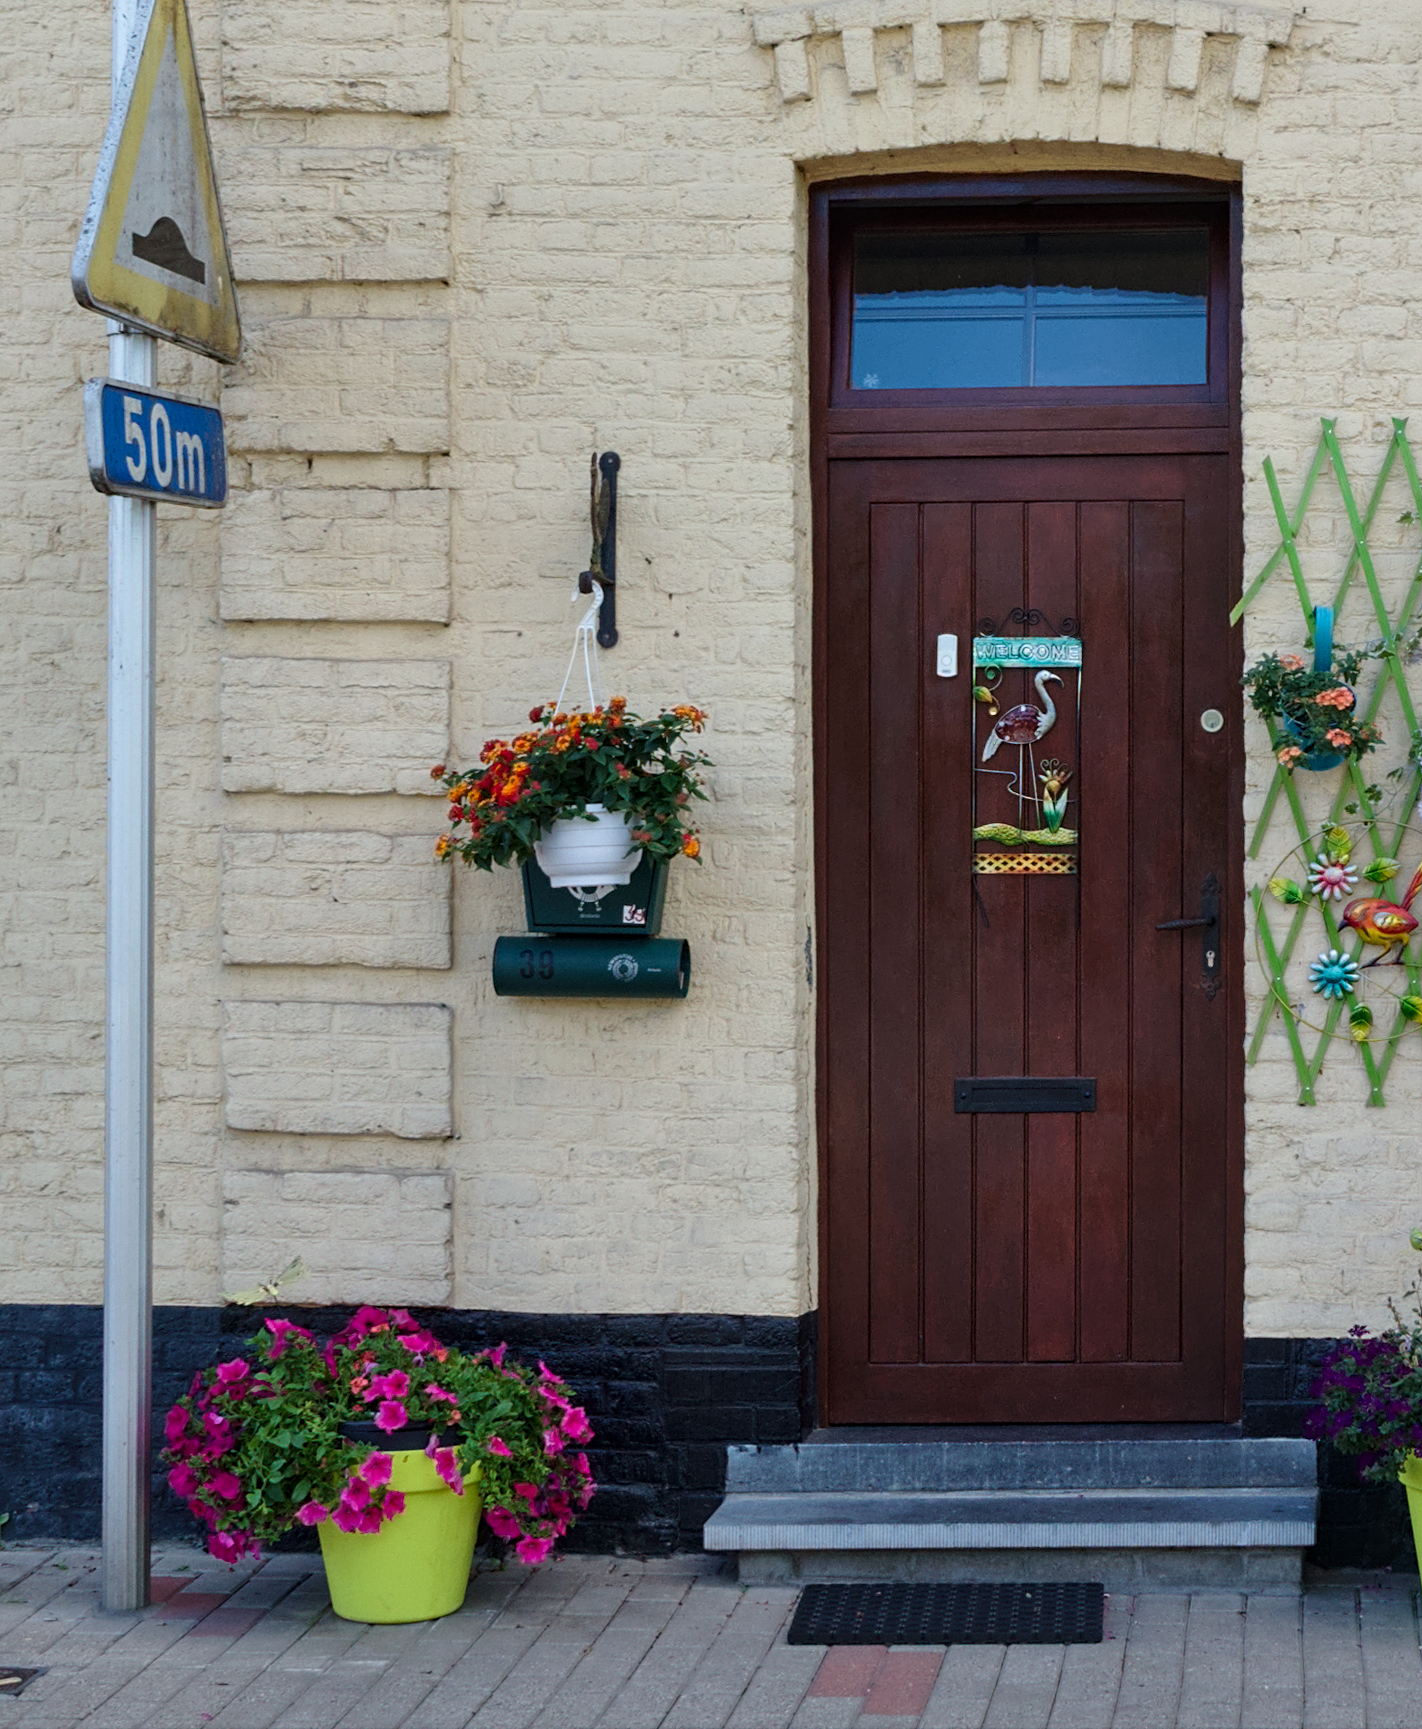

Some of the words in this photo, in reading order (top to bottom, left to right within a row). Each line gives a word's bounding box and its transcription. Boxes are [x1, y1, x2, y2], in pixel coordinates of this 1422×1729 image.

[123, 395, 205, 493] 50m
[976, 643, 1080, 661] WELCOME
[520, 949, 554, 980] 39
